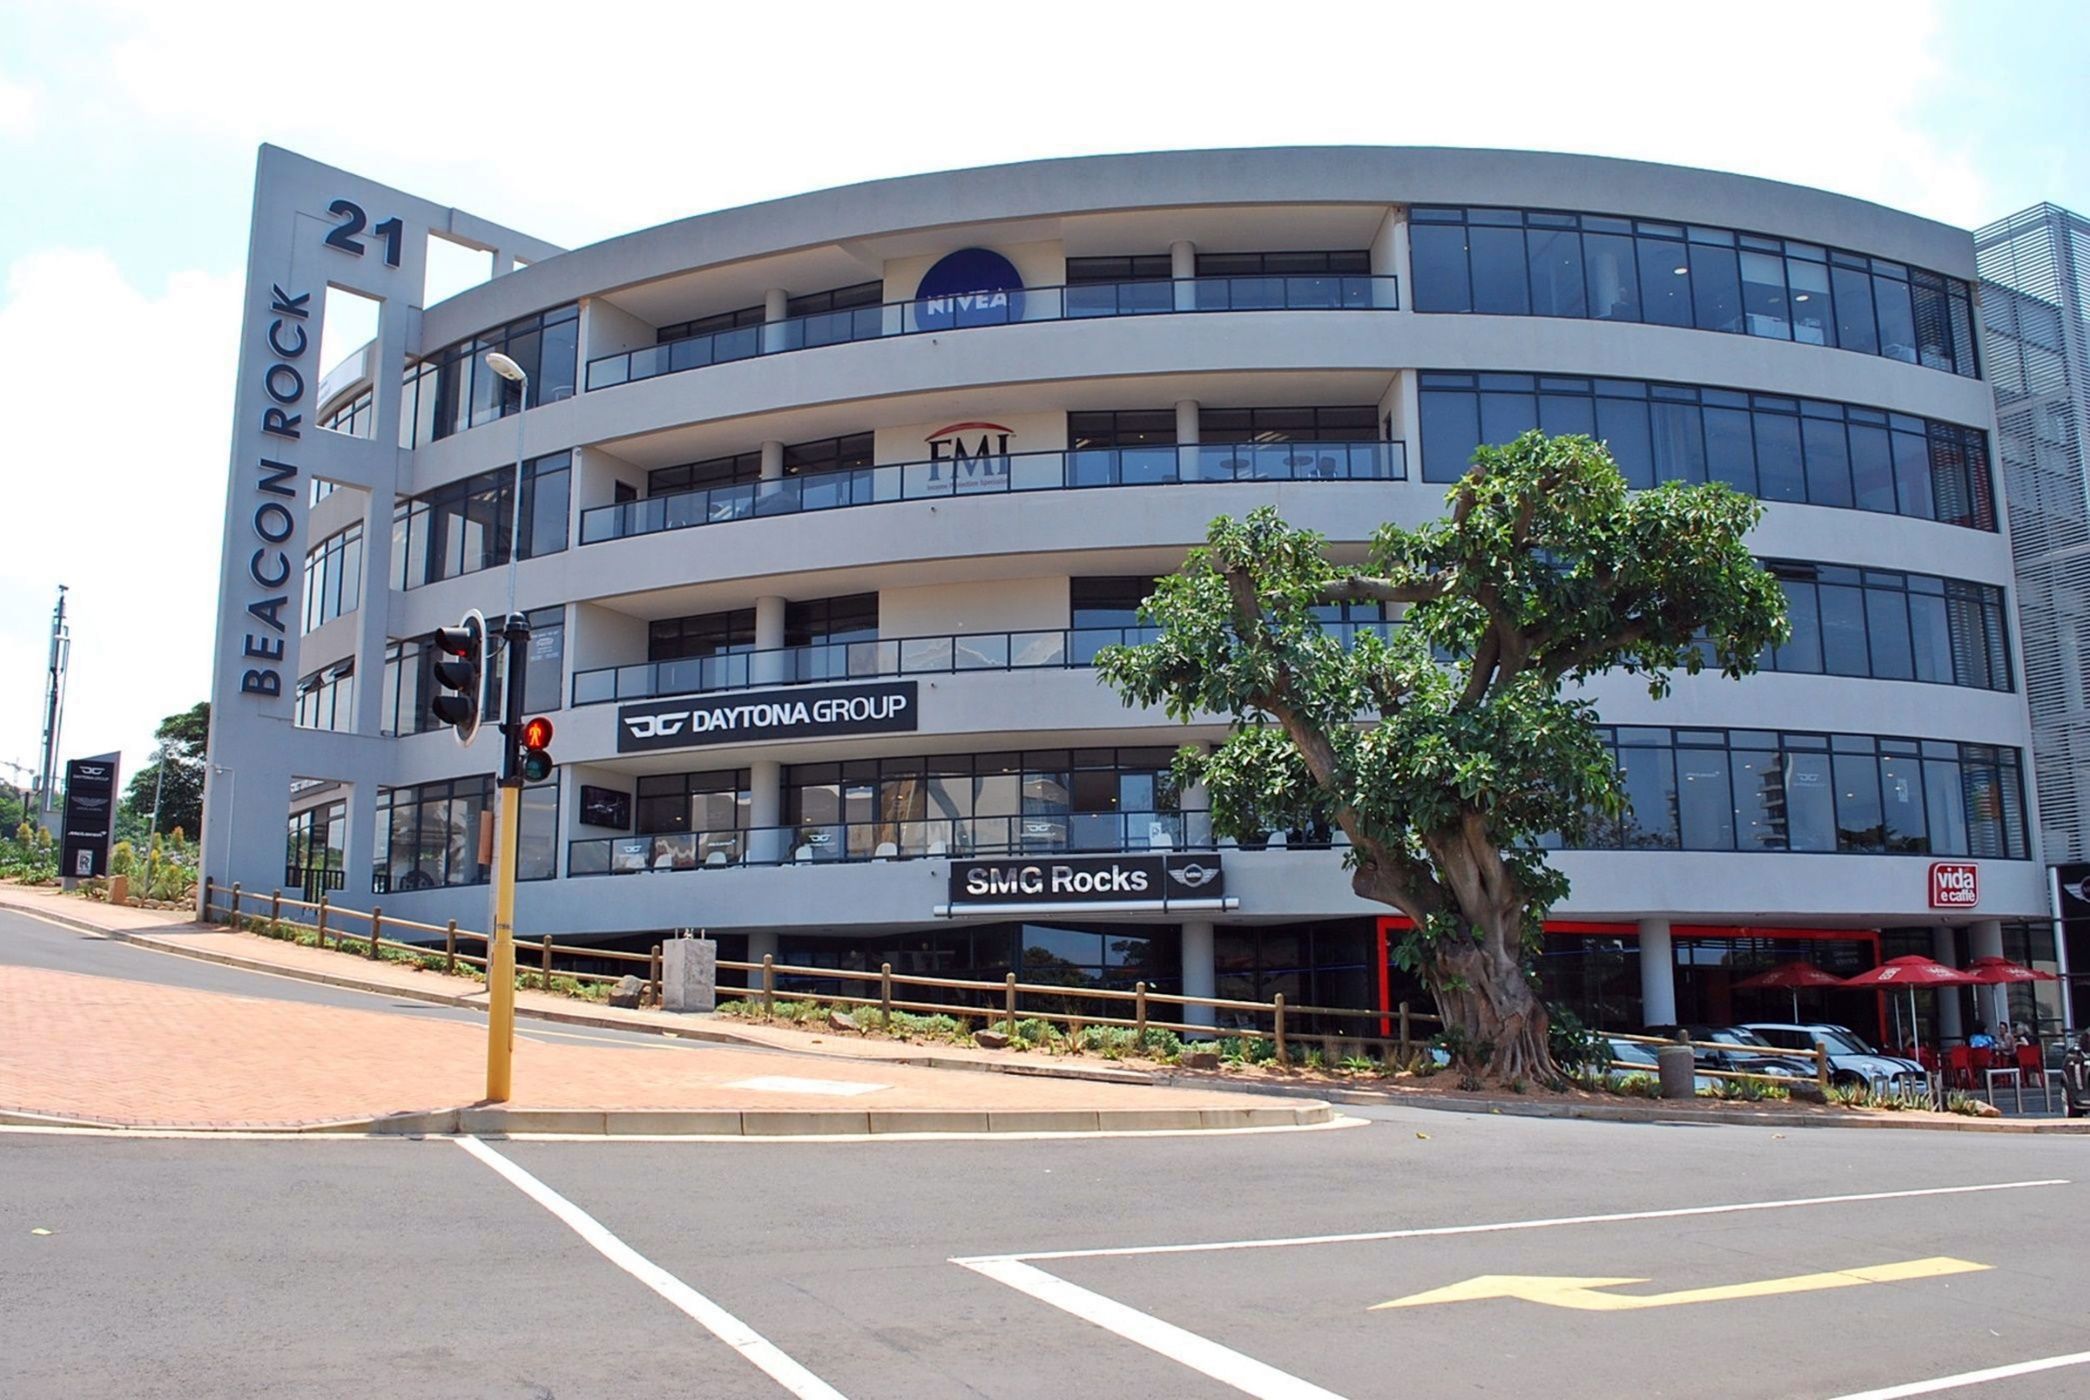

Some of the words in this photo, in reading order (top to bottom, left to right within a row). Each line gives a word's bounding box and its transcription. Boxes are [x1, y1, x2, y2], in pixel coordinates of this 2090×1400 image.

[323, 199, 403, 270] 21
[927, 287, 1008, 316] NIVEA
[261, 283, 311, 440] ROCK
[928, 433, 1010, 482] FMI
[240, 457, 299, 698] BEACON
[692, 702, 811, 733] DAYTONA
[812, 694, 907, 722] GROUP
[966, 866, 1044, 895] SMG
[1051, 864, 1149, 893] Rocks
[1937, 867, 1975, 889] vida
[1940, 890, 1949, 902] e
